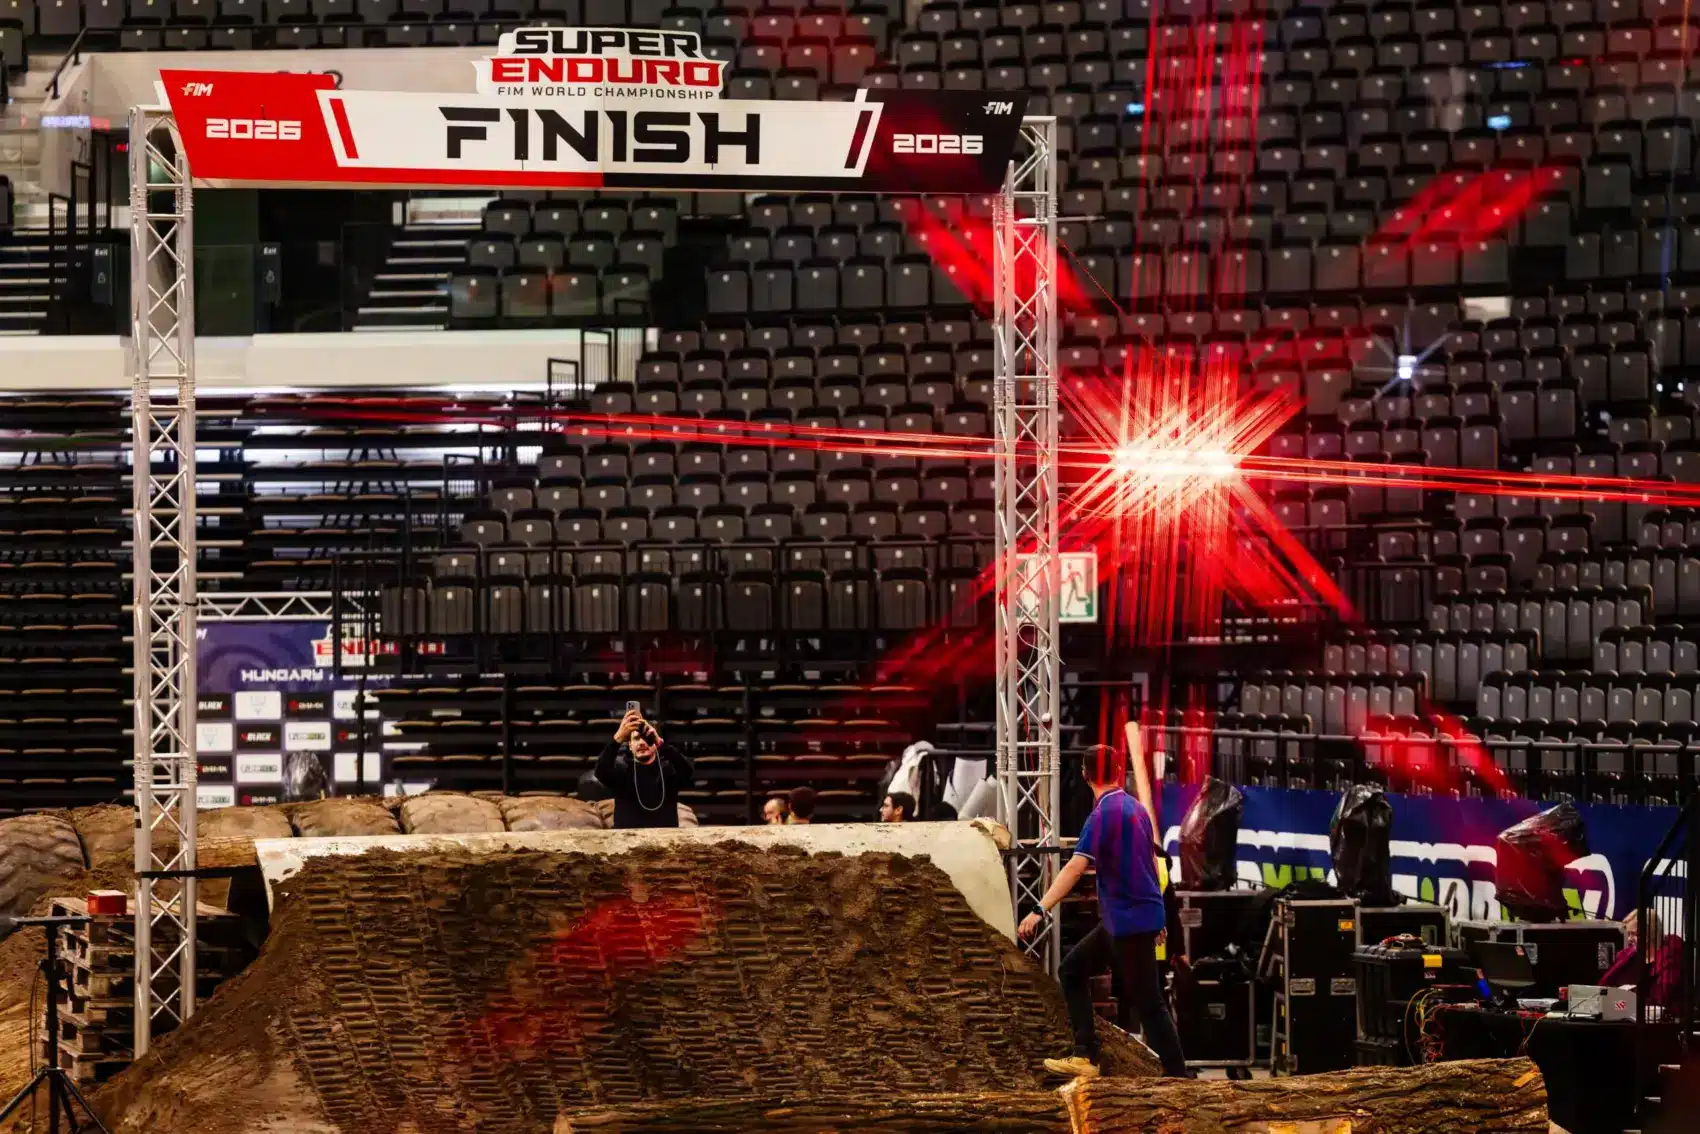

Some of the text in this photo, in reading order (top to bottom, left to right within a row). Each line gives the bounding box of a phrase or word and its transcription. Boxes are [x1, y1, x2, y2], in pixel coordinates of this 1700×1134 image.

[513, 30, 699, 57] SUPER
[490, 58, 721, 87] ENDURO
[183, 83, 213, 97] FIM
[498, 87, 713, 100] FIM WORLD CHAMPIONSHIP
[985, 101, 1013, 115] FIM
[206, 118, 302, 140] 2026
[438, 106, 760, 164] FINISH
[893, 133, 983, 154] 2026
[241, 668, 324, 682] HUNGARY
